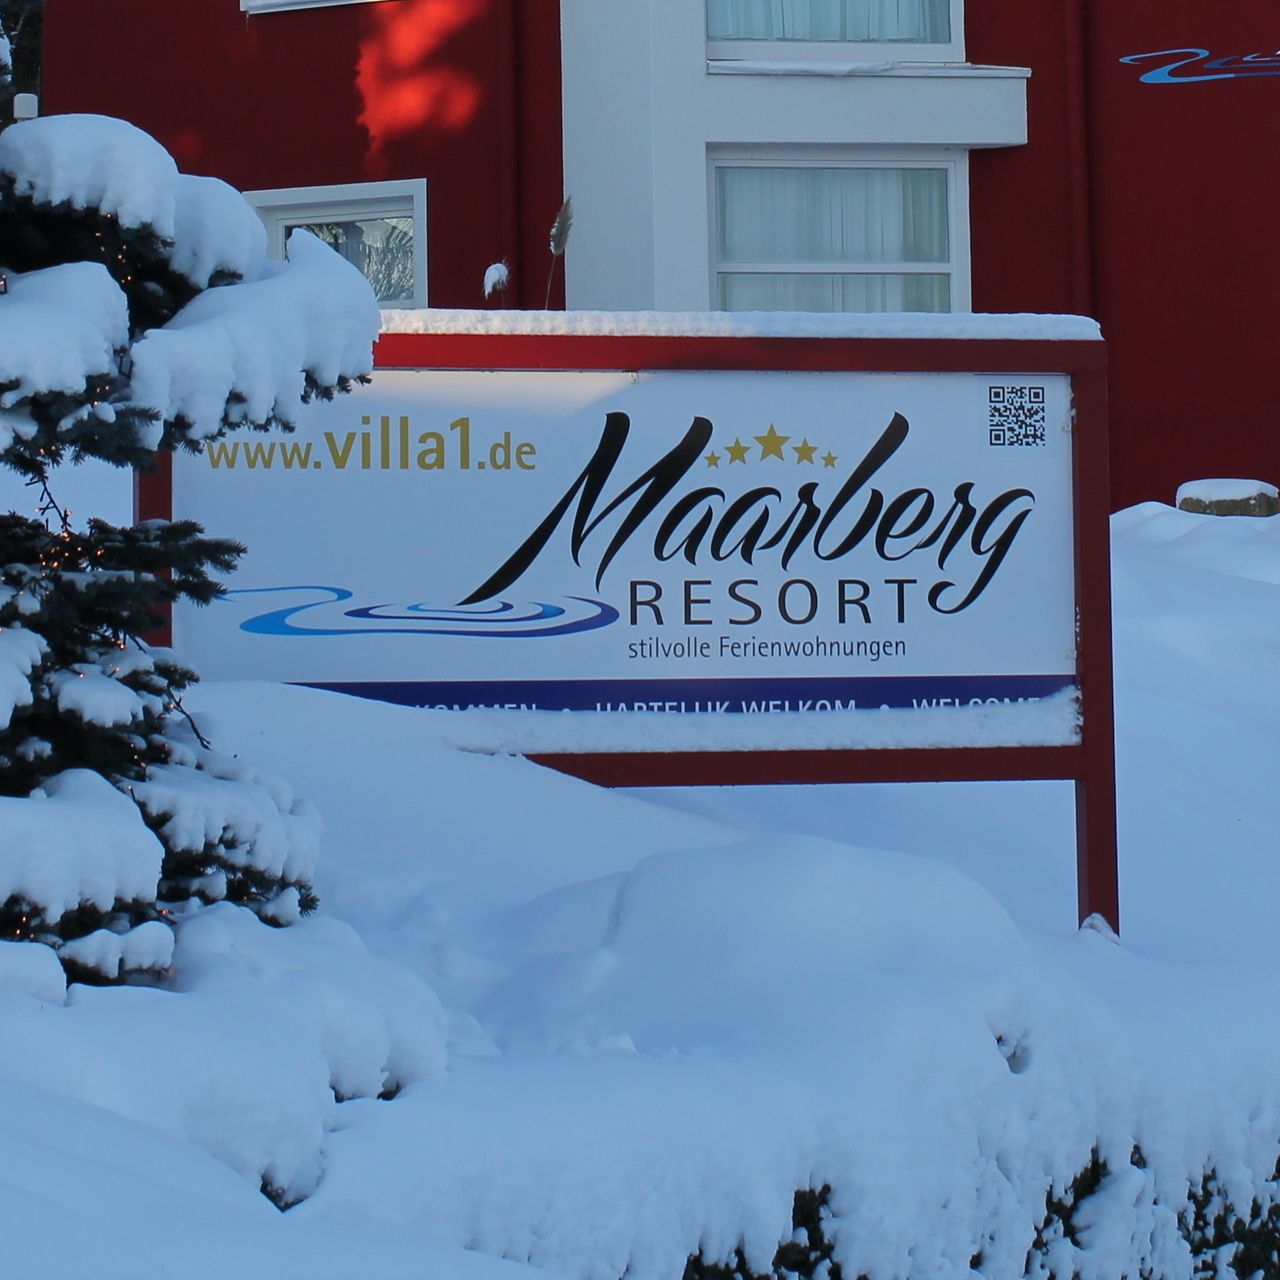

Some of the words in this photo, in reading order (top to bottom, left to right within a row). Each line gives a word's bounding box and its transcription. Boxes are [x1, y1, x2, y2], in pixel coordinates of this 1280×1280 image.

[207, 415, 537, 471] www.villa1.de
[456, 411, 1036, 615] Maarberg
[629, 578, 918, 626] RESORT
[628, 636, 711, 659] stilvolle
[719, 635, 907, 662] Ferienwohnungen
